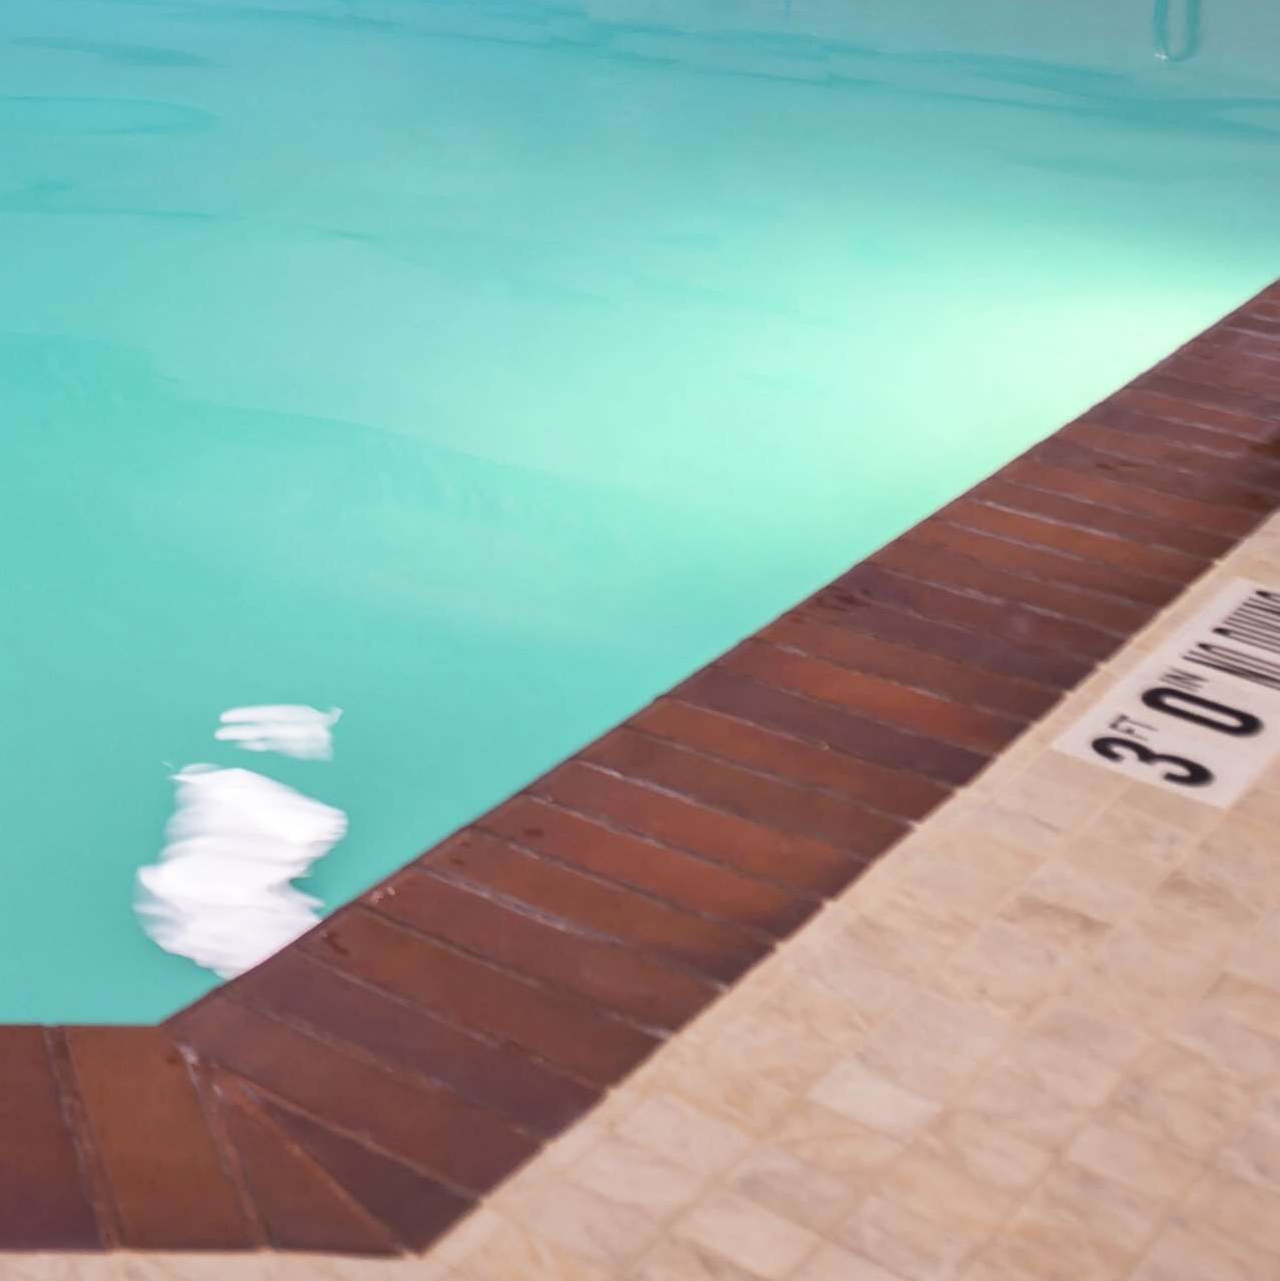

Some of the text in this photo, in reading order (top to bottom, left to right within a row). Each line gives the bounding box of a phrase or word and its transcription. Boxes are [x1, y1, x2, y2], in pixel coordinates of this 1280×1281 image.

[1159, 667, 1210, 692] IN
[1108, 714, 1159, 742] FT
[1141, 687, 1265, 737] 0
[1091, 736, 1216, 787] 3
